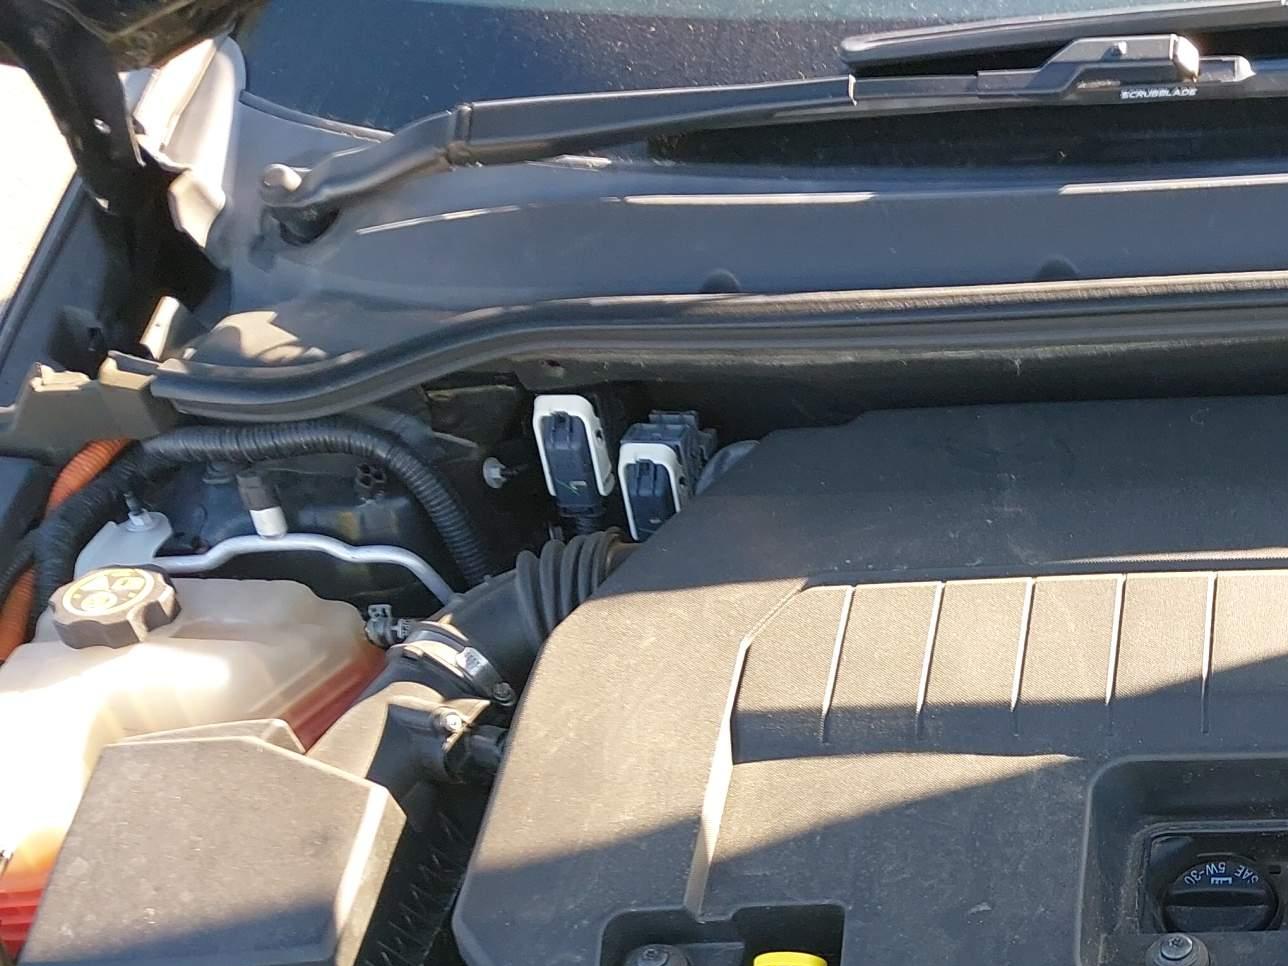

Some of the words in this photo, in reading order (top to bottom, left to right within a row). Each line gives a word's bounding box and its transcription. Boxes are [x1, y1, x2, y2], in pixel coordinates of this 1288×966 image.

[1120, 88, 1197, 99] SCRUBBLADE
[1184, 861, 1226, 885] 5W-30
[1233, 864, 1259, 884] SAE
